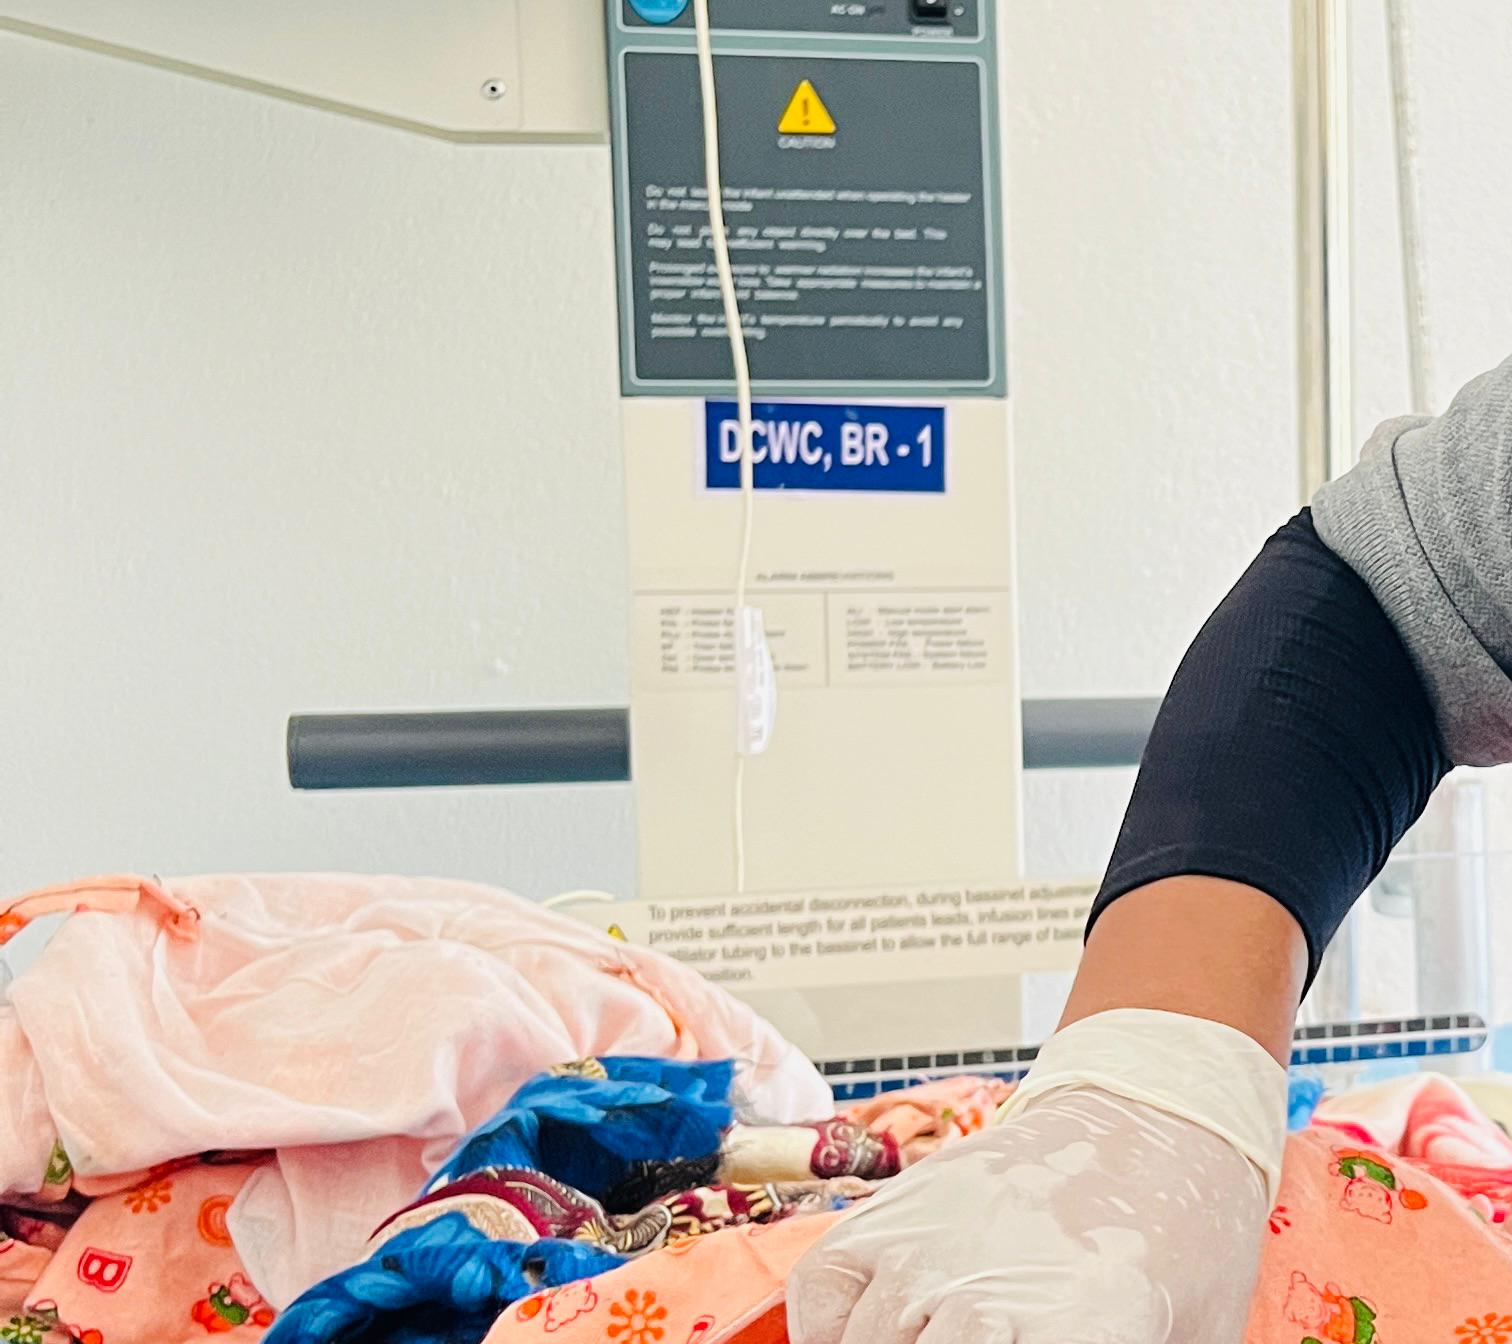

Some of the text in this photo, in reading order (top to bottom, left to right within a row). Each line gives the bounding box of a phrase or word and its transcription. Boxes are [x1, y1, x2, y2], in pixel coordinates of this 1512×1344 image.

[719, 420, 832, 472] DCWC,
[840, 422, 890, 467] BR
[916, 424, 932, 468] 1
[650, 904, 665, 920] To
[670, 904, 726, 921] prevent
[730, 900, 804, 916] accidental
[809, 894, 911, 912] disconnection,
[917, 890, 961, 906] during
[965, 887, 1024, 902] bassinet
[649, 927, 702, 944] provide
[708, 924, 773, 939] sufficient
[777, 919, 821, 936] length
[826, 918, 845, 931] for
[850, 916, 866, 930] all
[870, 913, 927, 932] patients
[978, 908, 1032, 923] infusion
[1037, 907, 1068, 921] lines
[722, 944, 766, 961] tubing
[772, 944, 785, 957] to
[790, 940, 812, 955] the
[816, 937, 877, 954] bassinet
[882, 938, 895, 952] to
[900, 933, 935, 949] allow
[940, 934, 962, 947] the
[967, 930, 987, 945] full
[992, 932, 1031, 946] range
[1036, 927, 1050, 941] of
